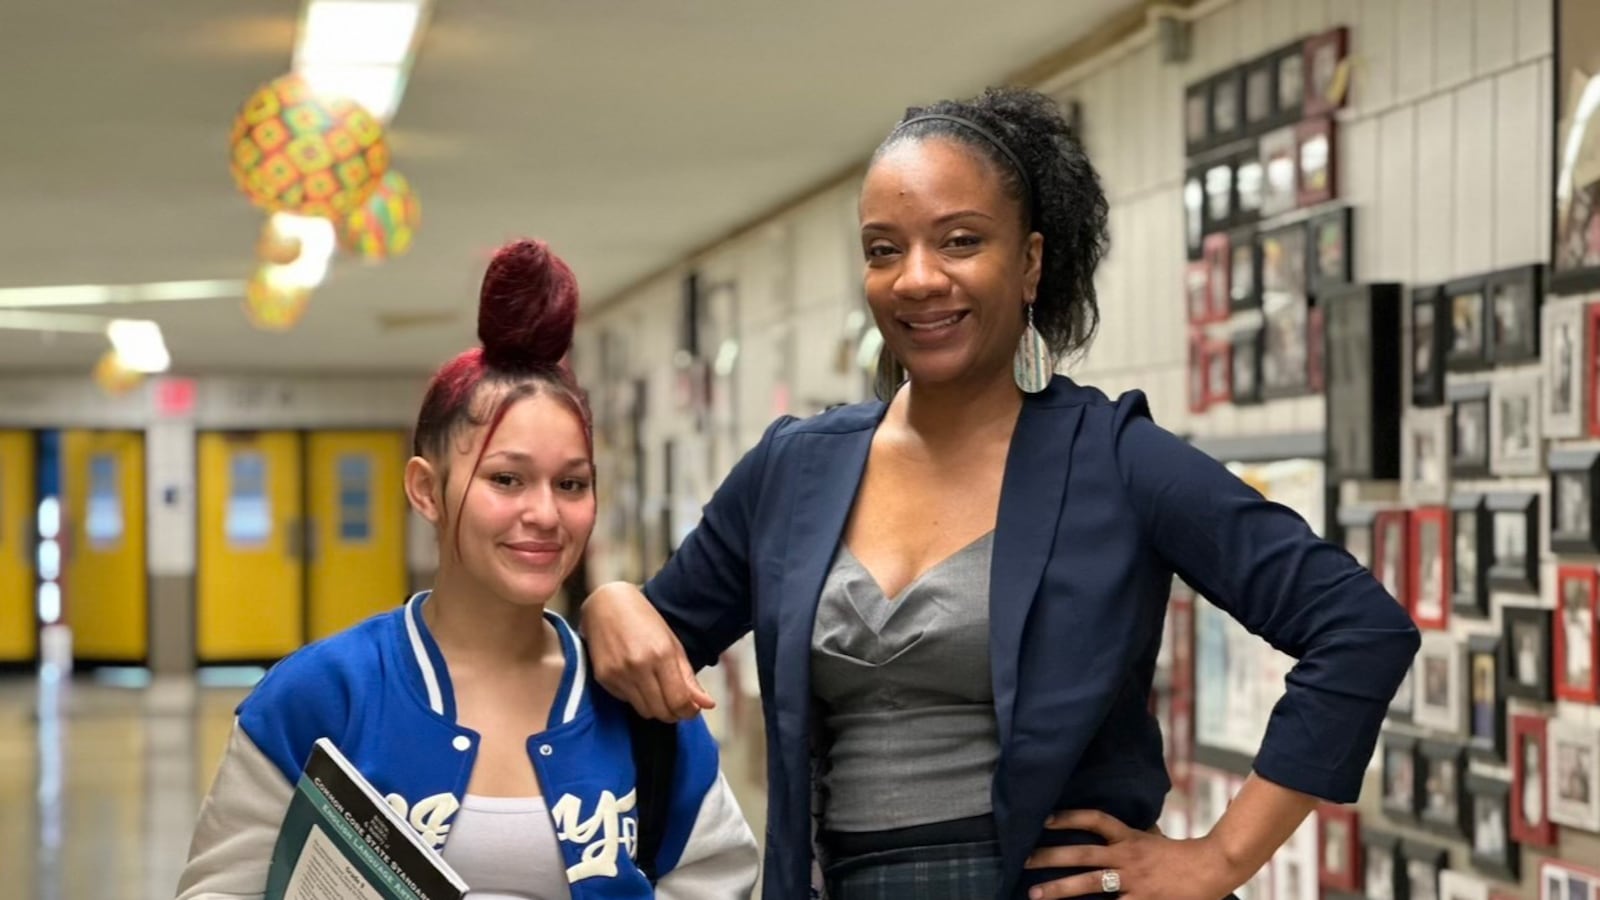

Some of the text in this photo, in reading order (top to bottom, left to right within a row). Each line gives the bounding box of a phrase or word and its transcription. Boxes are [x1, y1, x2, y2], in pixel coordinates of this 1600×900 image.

[314, 777, 345, 813] COMMON
[344, 811, 366, 837] CORE
[365, 834, 391, 864] STATE
[390, 860, 431, 900] STANDAR
[321, 804, 353, 840] ENGLISH
[352, 838, 394, 884] LANGUAGE
[393, 883, 414, 900] ART
